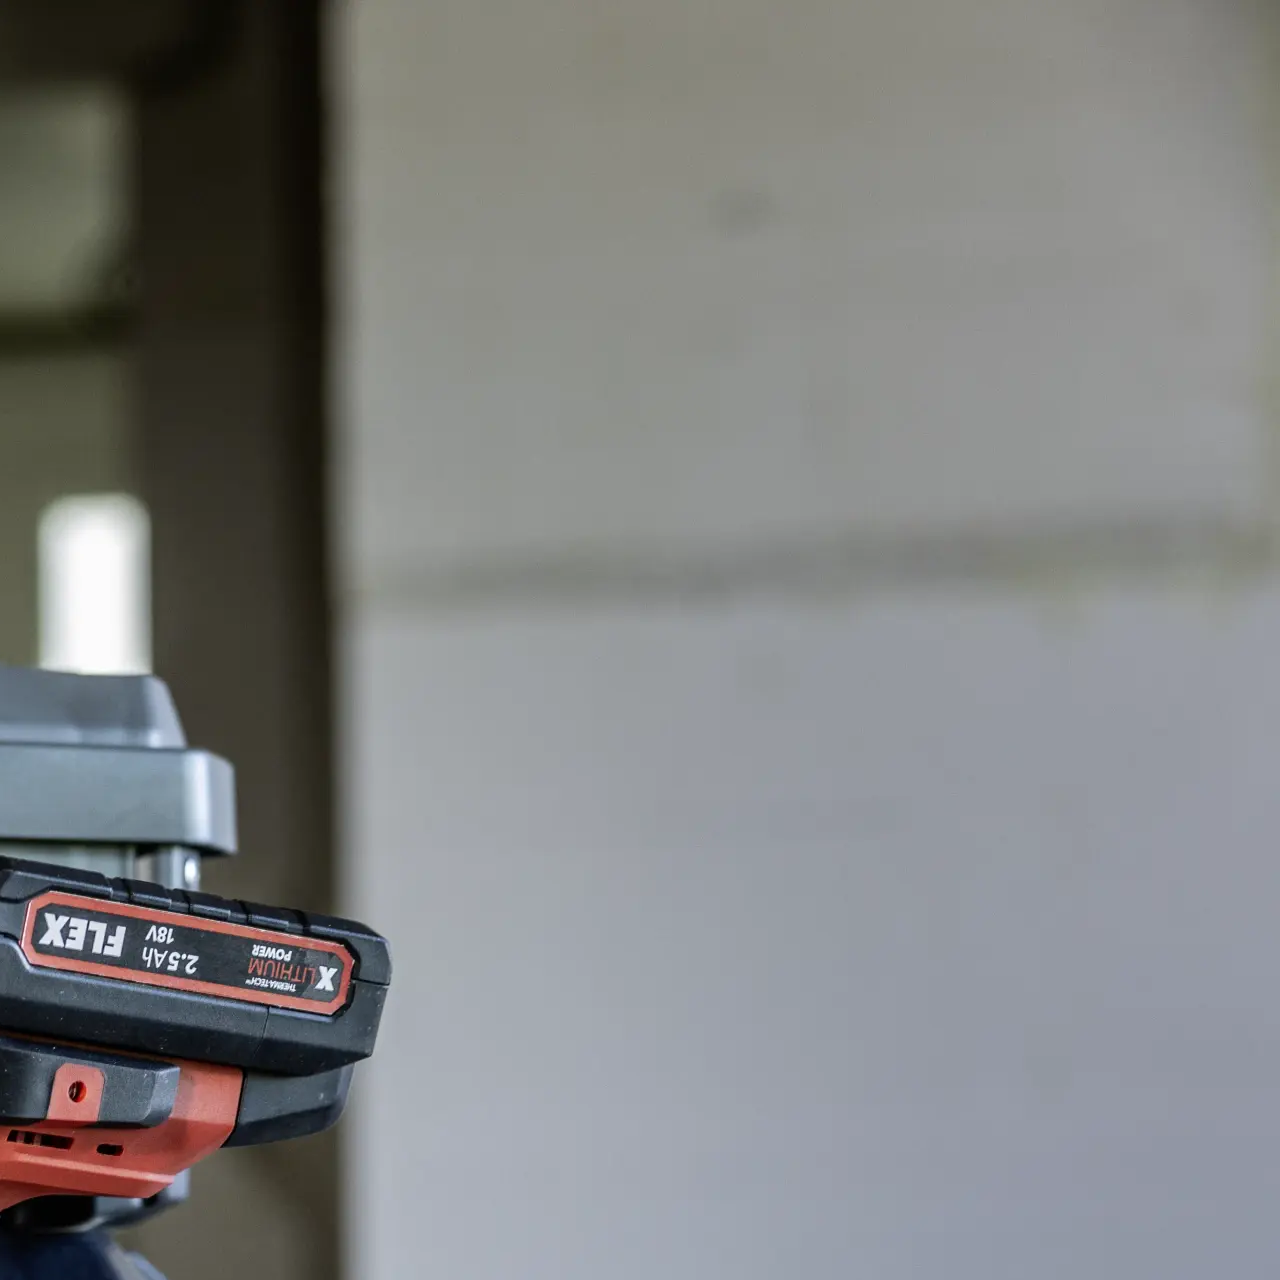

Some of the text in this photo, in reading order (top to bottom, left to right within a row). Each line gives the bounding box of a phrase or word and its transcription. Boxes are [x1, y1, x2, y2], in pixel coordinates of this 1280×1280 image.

[39, 912, 127, 958] FLEX
[145, 925, 174, 945] 18V
[251, 944, 292, 962] POWER
[247, 957, 316, 985] LITHIUM
